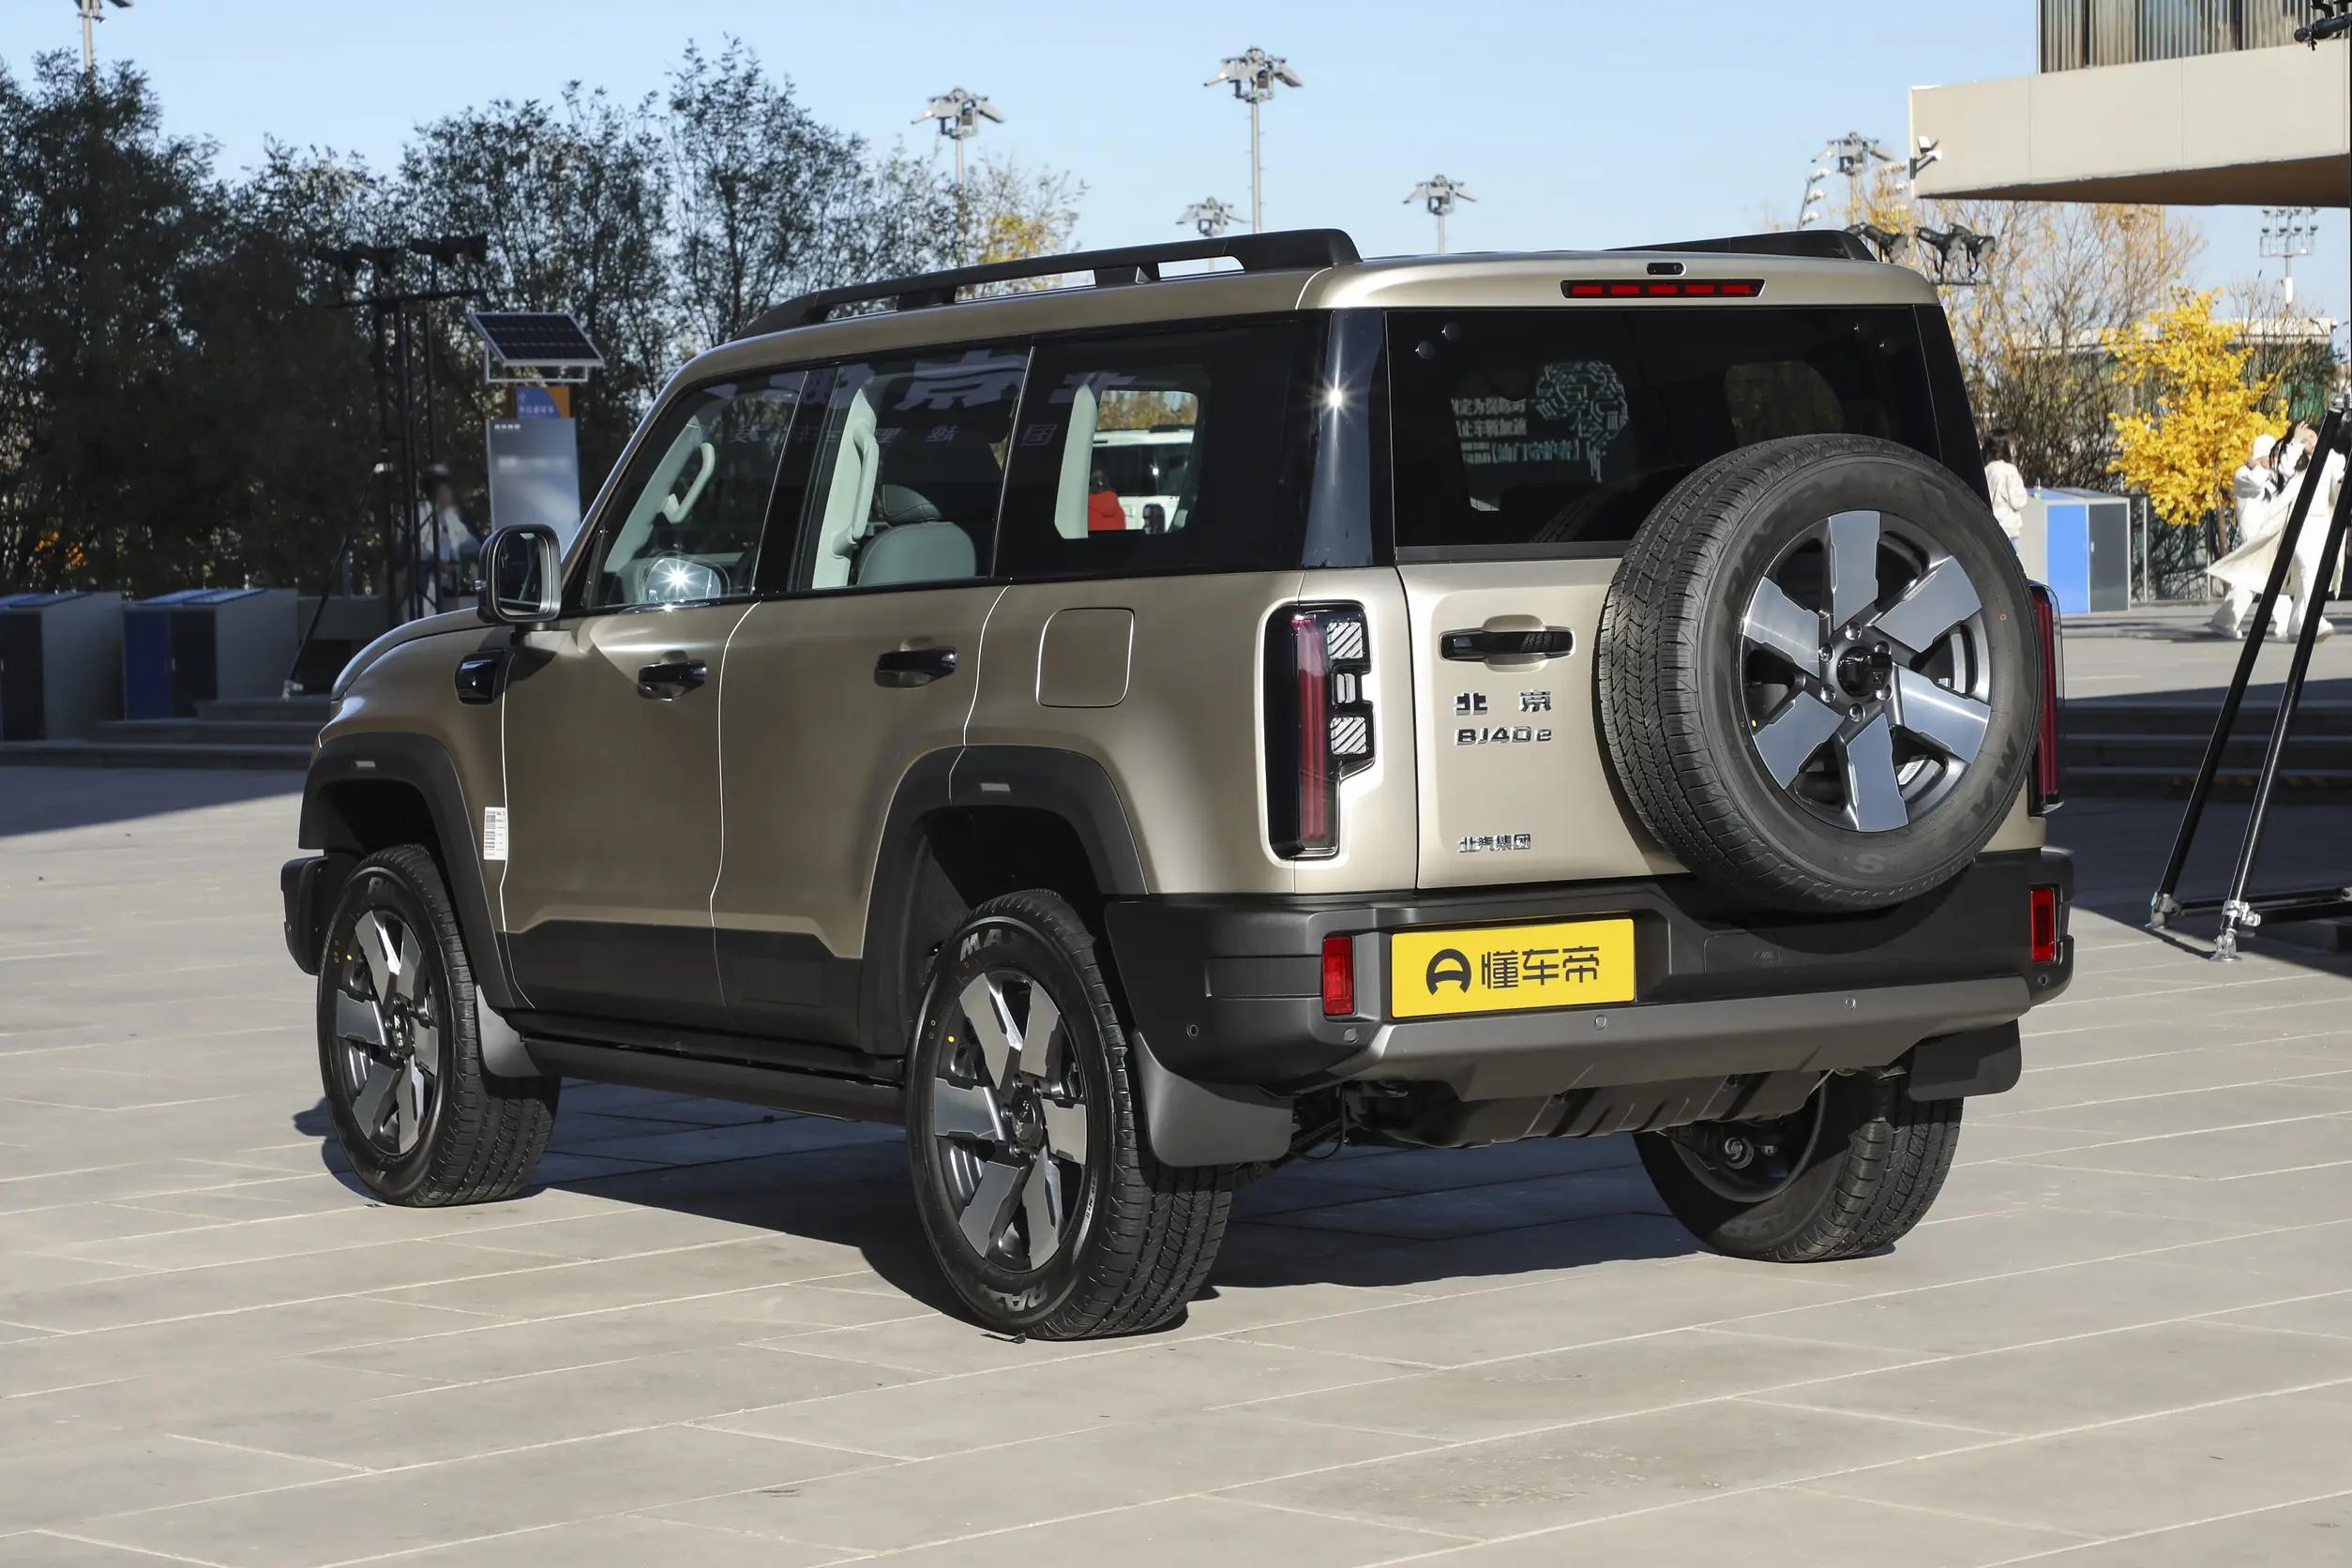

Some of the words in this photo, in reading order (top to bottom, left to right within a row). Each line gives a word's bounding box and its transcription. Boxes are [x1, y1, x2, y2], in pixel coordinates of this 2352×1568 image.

[1454, 689, 1552, 716] 北京
[1455, 726, 1552, 746] BJ40e
[1458, 833, 1531, 853] 北汽集团
[1481, 945, 1600, 989] 懂车帝
